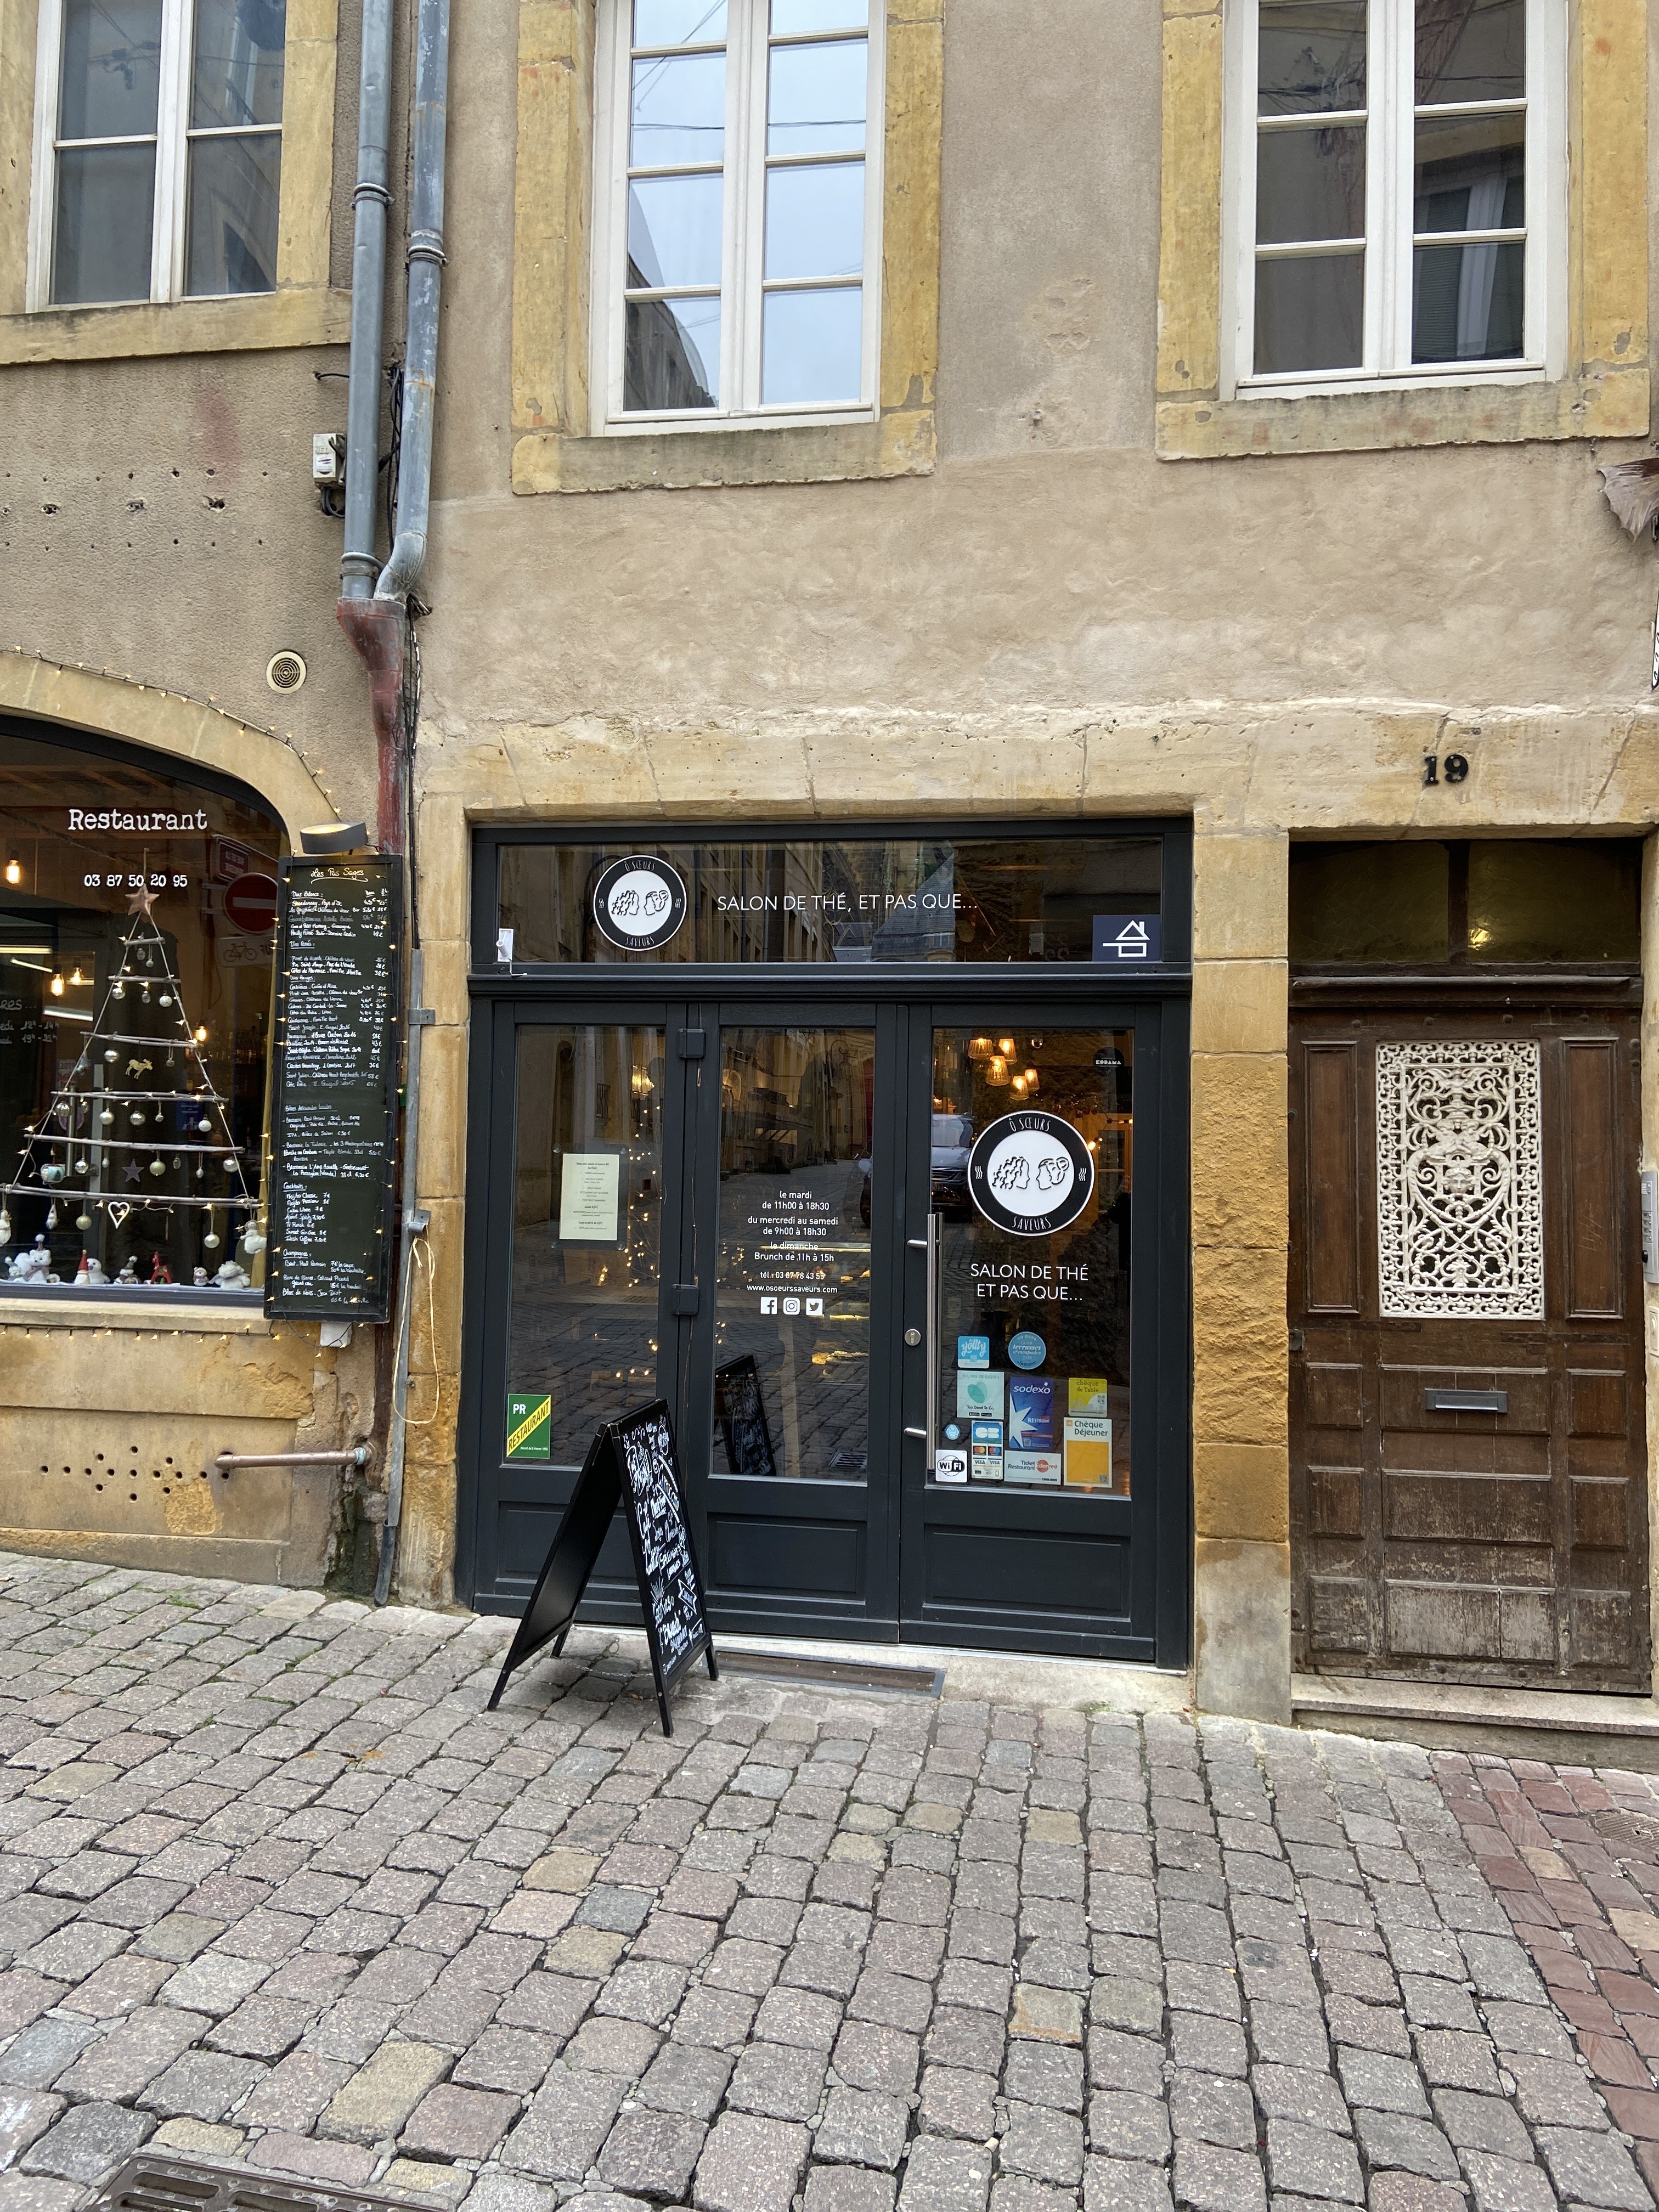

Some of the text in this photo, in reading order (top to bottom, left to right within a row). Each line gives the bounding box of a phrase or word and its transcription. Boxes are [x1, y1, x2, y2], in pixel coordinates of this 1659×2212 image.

[1425, 754, 1469, 786] 19
[68, 809, 207, 832] Restaurant
[311, 868, 324, 878] Les
[328, 868, 340, 876] Pas
[84, 874, 188, 887] 03 87 50 20 95
[717, 893, 978, 913] SALON DE THÉ, ET PAS QUE...
[1020, 1118, 1052, 1131] SŒURS
[775, 1201, 797, 1210] 11h00
[799, 1201, 803, 1210] à
[806, 1202, 830, 1210] 18h30
[760, 1216, 795, 1224] mercredi
[1012, 1216, 1052, 1231] SAVEURS
[780, 1242, 818, 1250] dimanche
[754, 1252, 834, 1262] Brunch de 11h à 15h
[970, 1263, 1088, 1280] SALON DE THÉ
[747, 1285, 838, 1294] www.osoeurssaveurs.com
[978, 1284, 1083, 1301] ET PAS QUE...
[1013, 1384, 1051, 1394] sodexo
[513, 1404, 526, 1414] PR
[508, 1401, 549, 1453] RESTAURANT
[1074, 1420, 1103, 1430] Chèque
[1074, 1427, 1109, 1437] Déjeuner
